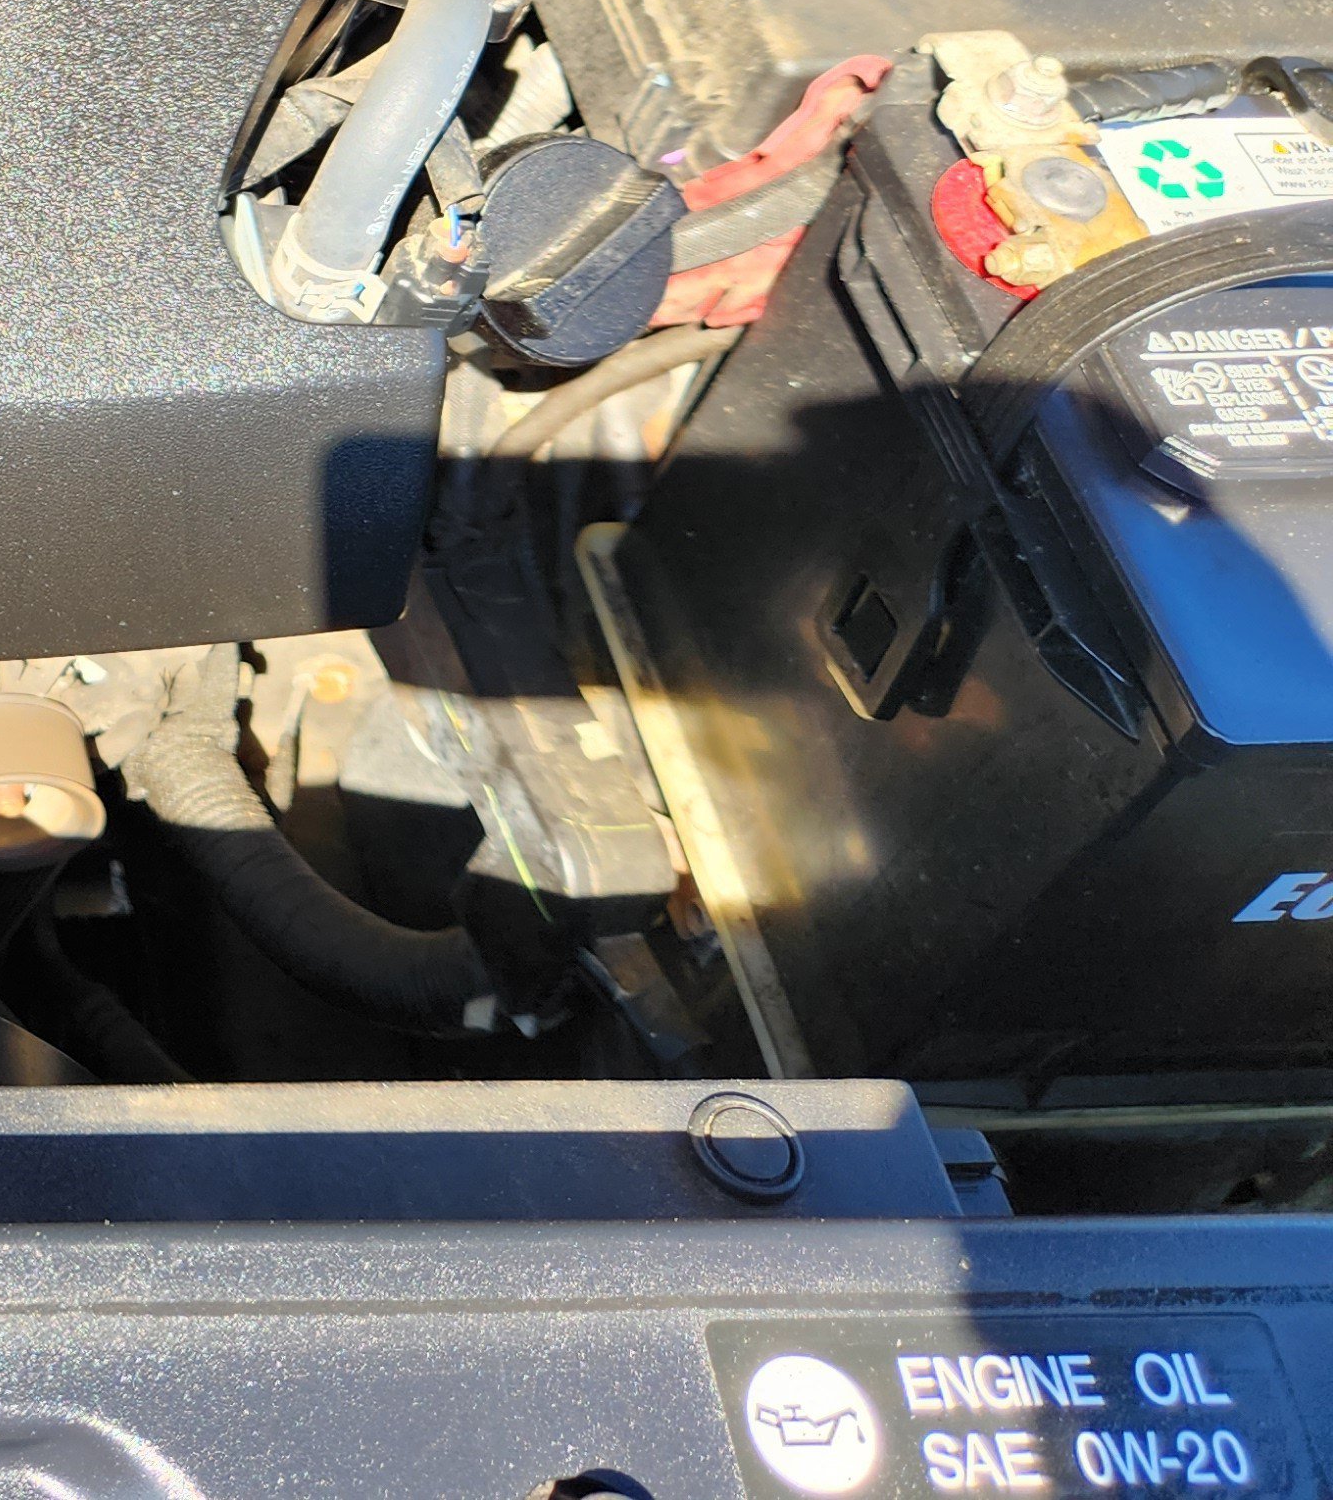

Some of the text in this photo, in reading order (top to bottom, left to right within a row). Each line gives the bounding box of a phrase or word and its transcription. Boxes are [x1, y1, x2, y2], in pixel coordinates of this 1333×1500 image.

[1288, 140, 1331, 155] WA
[1170, 328, 1292, 352] DANGER
[1224, 363, 1279, 378] SHIELD
[1234, 377, 1275, 392] EYES
[1205, 391, 1288, 407] EXPLOSIVE
[1215, 407, 1268, 421] GASES
[897, 1352, 1233, 1411] ENGINE OIL
[922, 1428, 1253, 1489] SAE 0W-20
